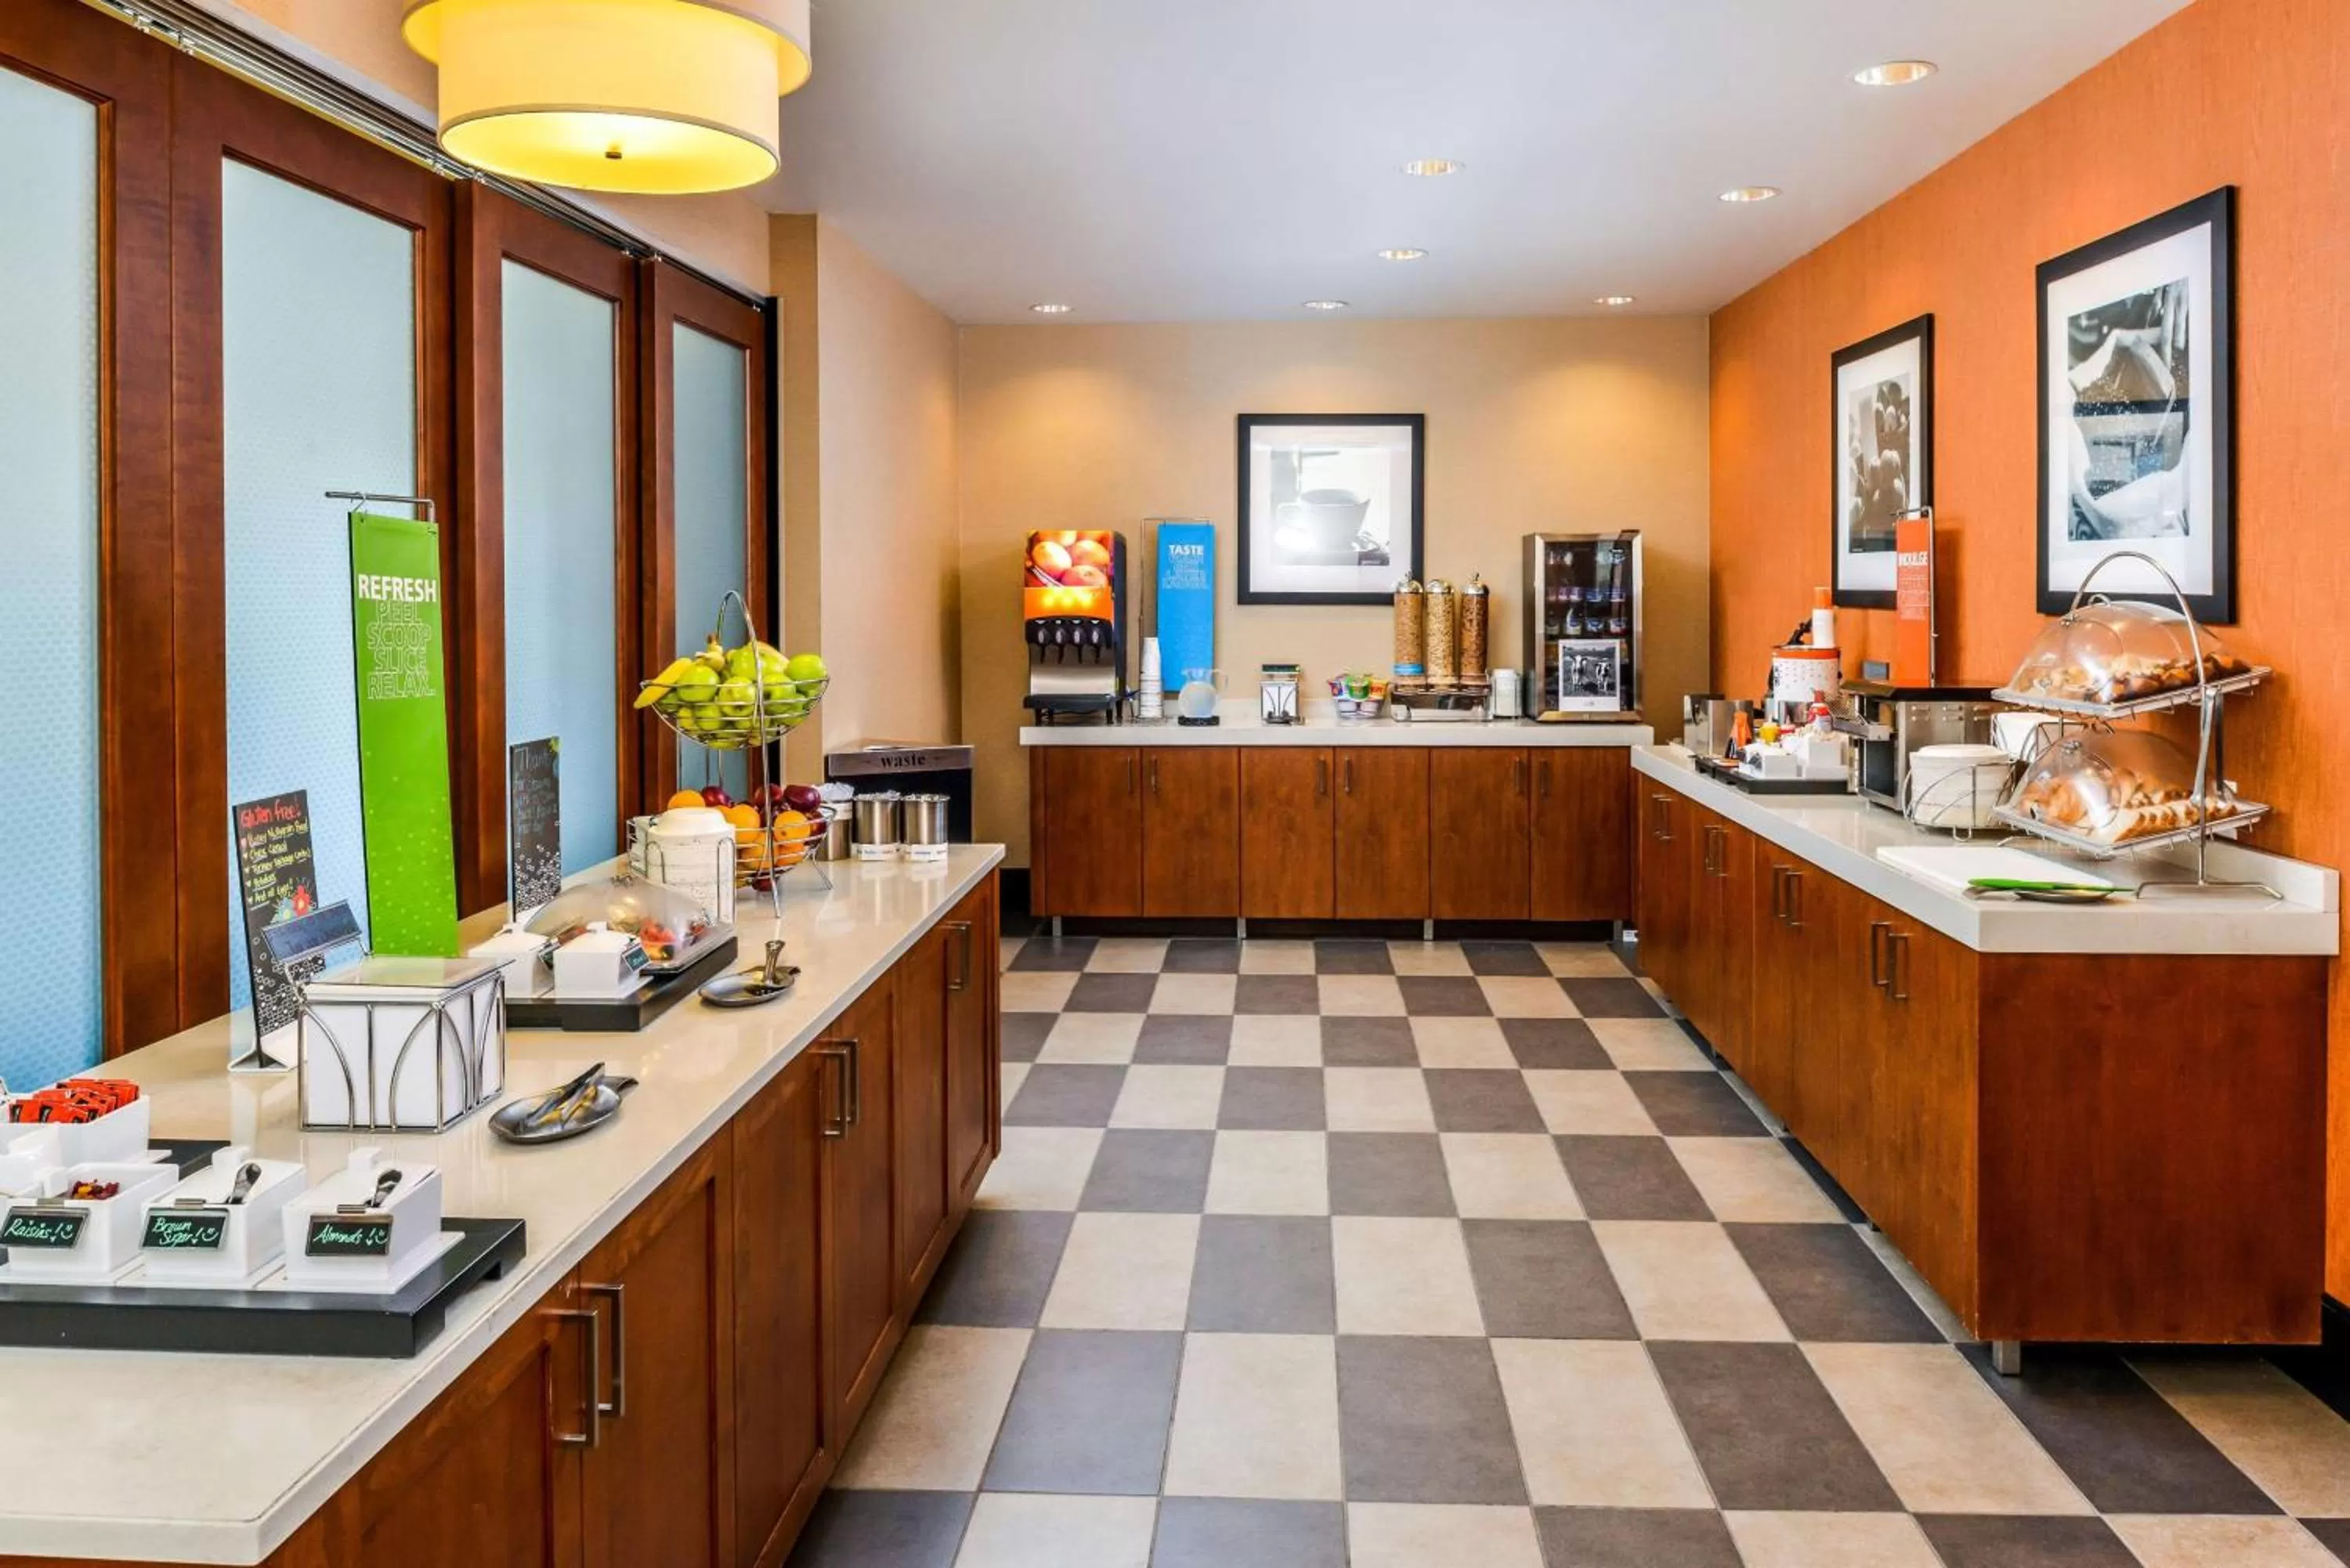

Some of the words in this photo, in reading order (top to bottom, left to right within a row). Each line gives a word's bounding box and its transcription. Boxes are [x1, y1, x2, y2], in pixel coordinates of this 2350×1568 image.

[1168, 544, 1204, 555] TASTE
[357, 573, 437, 602] REFRESH
[376, 600, 422, 623] PEEL
[367, 622, 432, 649] SCOOP
[374, 647, 427, 674] SLICE
[880, 753, 927, 768] waste
[152, 1216, 192, 1233] Brown
